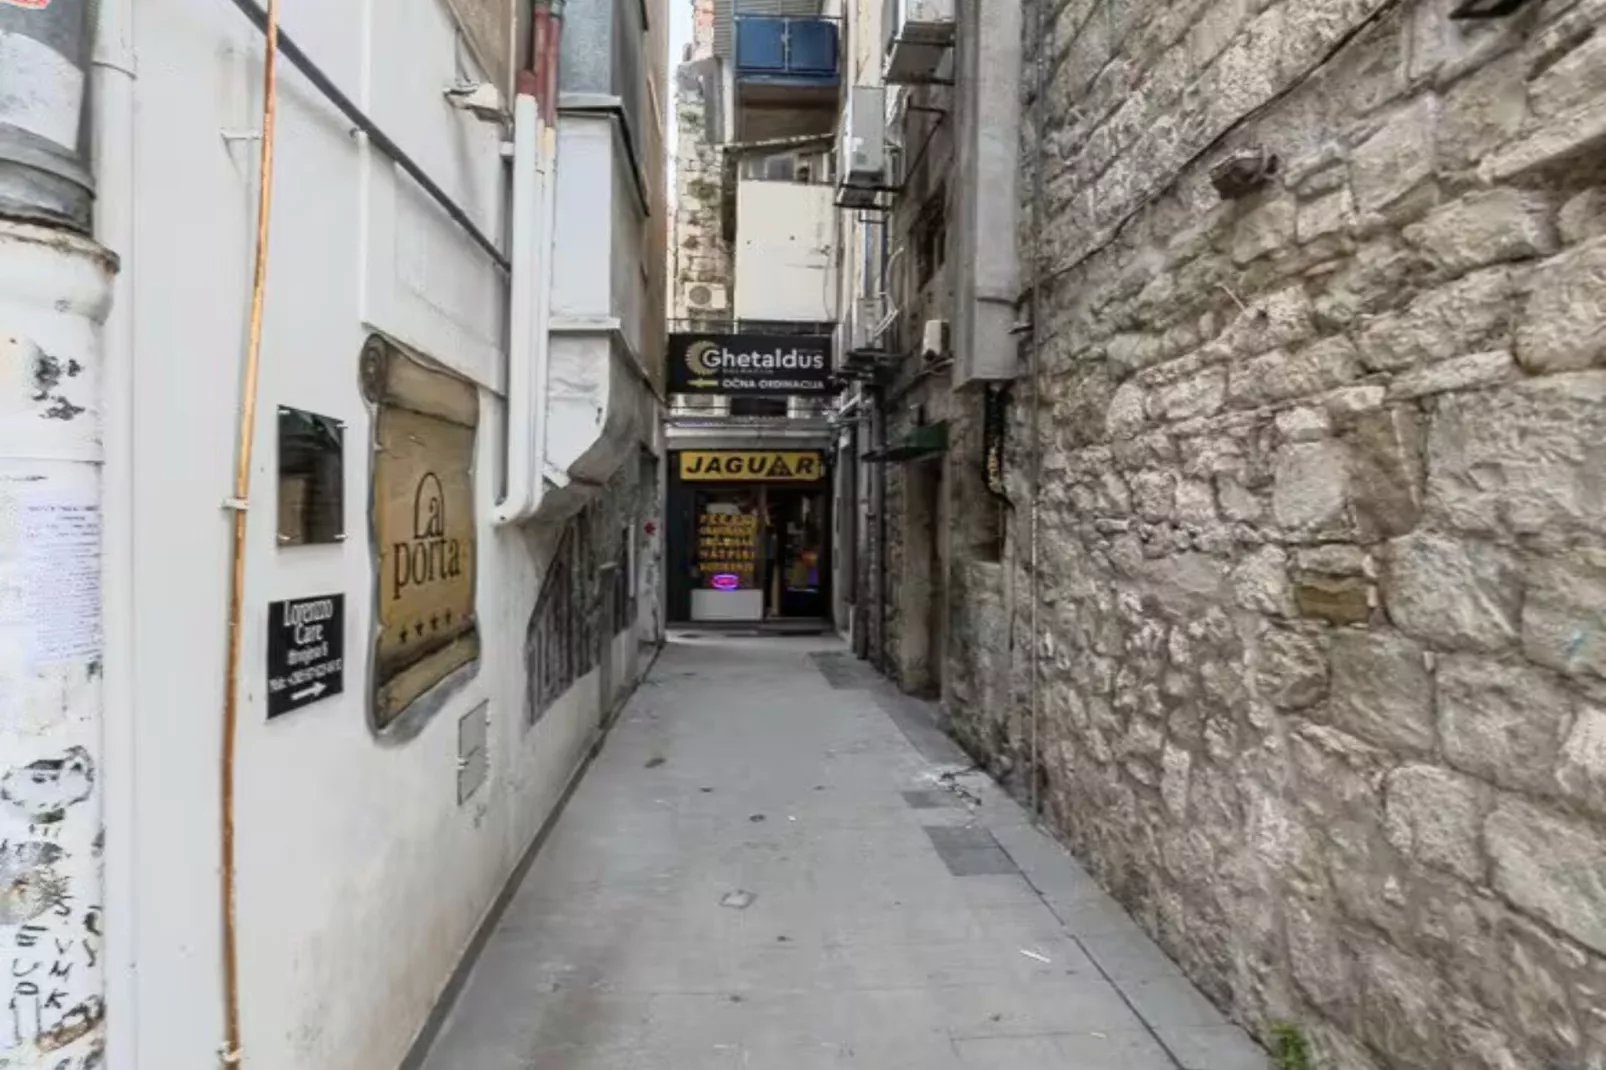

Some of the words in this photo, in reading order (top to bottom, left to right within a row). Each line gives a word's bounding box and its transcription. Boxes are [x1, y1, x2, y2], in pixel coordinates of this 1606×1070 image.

[702, 347, 824, 369] Ghetaldus
[722, 377, 757, 389] OČNA
[758, 379, 825, 390] ORDINACIJA
[686, 454, 816, 477] JAGUAR
[393, 538, 462, 600] porta
